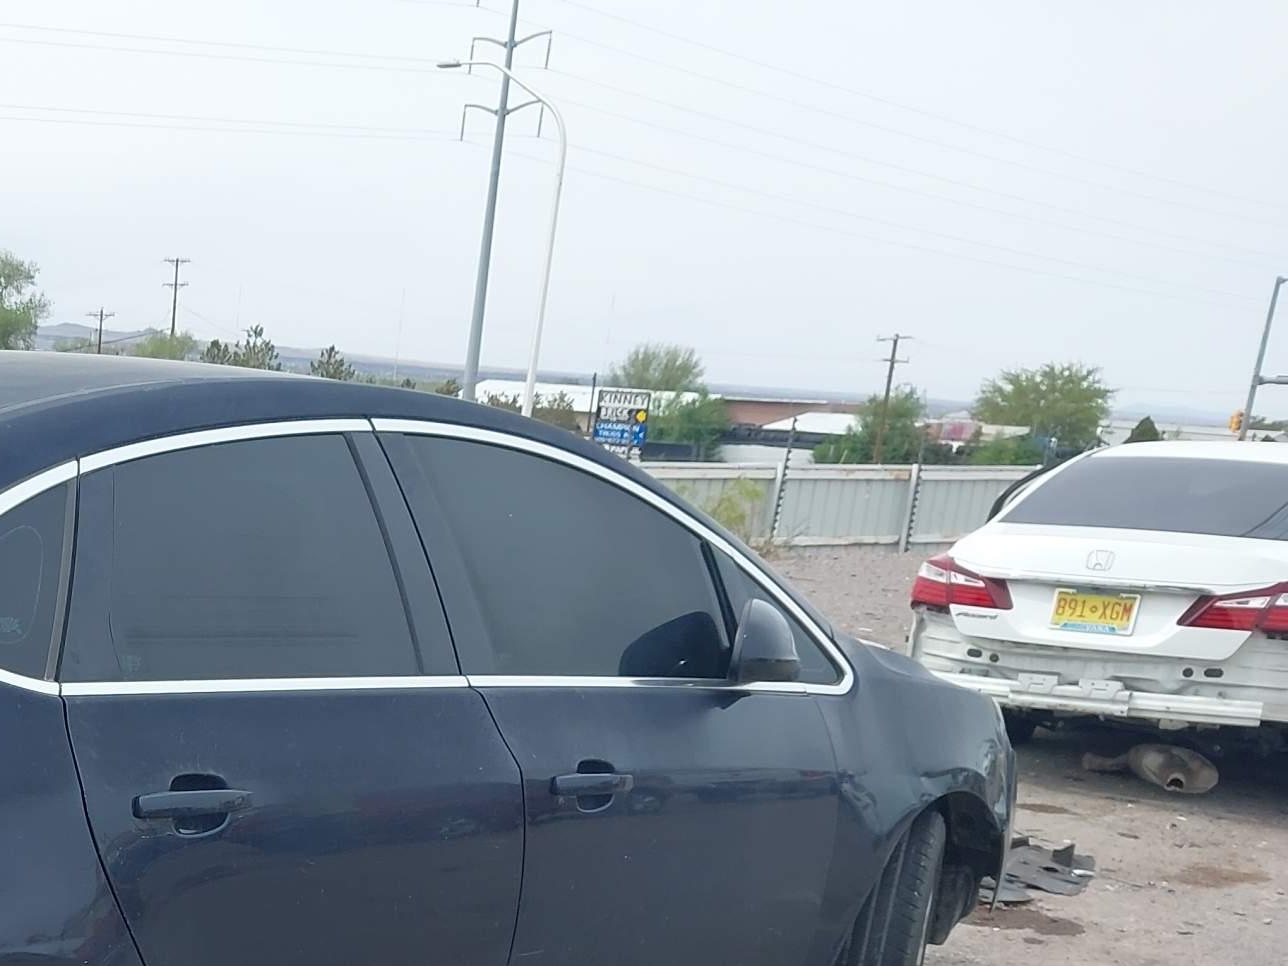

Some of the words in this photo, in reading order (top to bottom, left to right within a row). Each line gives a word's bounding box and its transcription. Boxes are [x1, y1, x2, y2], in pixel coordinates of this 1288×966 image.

[599, 391, 648, 406] KINNEY
[1055, 597, 1086, 618] 891
[1098, 600, 1134, 623] XGM
